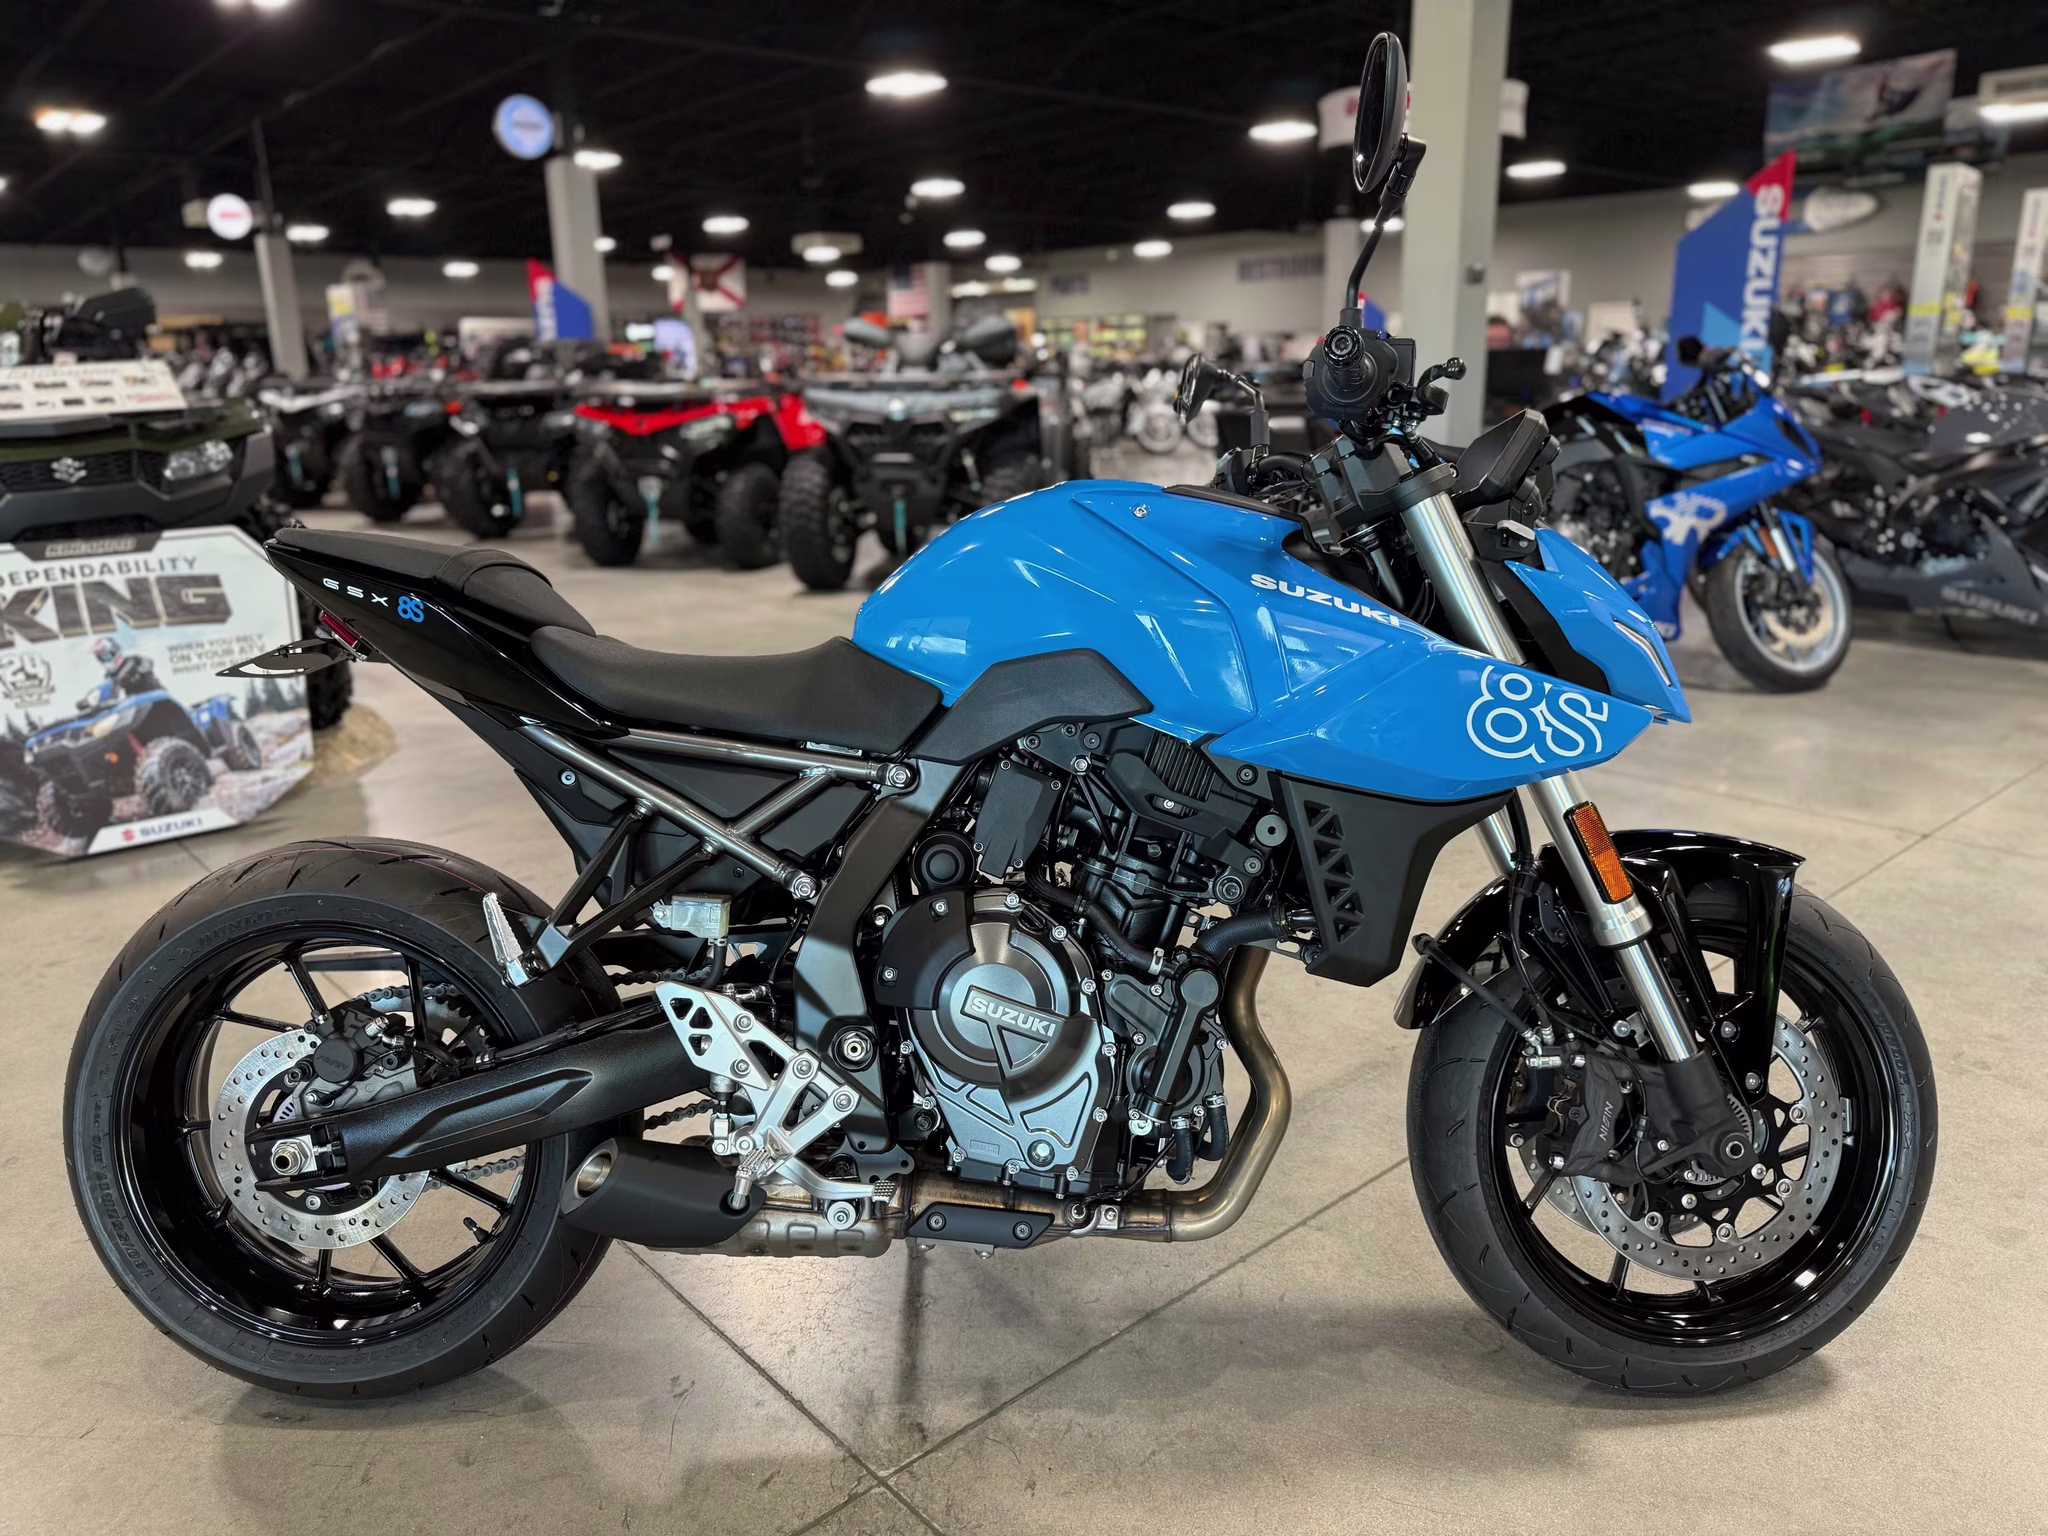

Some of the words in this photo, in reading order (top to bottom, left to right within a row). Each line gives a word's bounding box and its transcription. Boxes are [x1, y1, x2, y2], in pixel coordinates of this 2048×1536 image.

[1738, 184, 1785, 349] SUZUKI
[323, 578, 389, 607] GSX
[1250, 573, 1400, 627] SUZUKI
[140, 818, 203, 837] SUZUKI
[969, 996, 1057, 1038] SUZUKI
